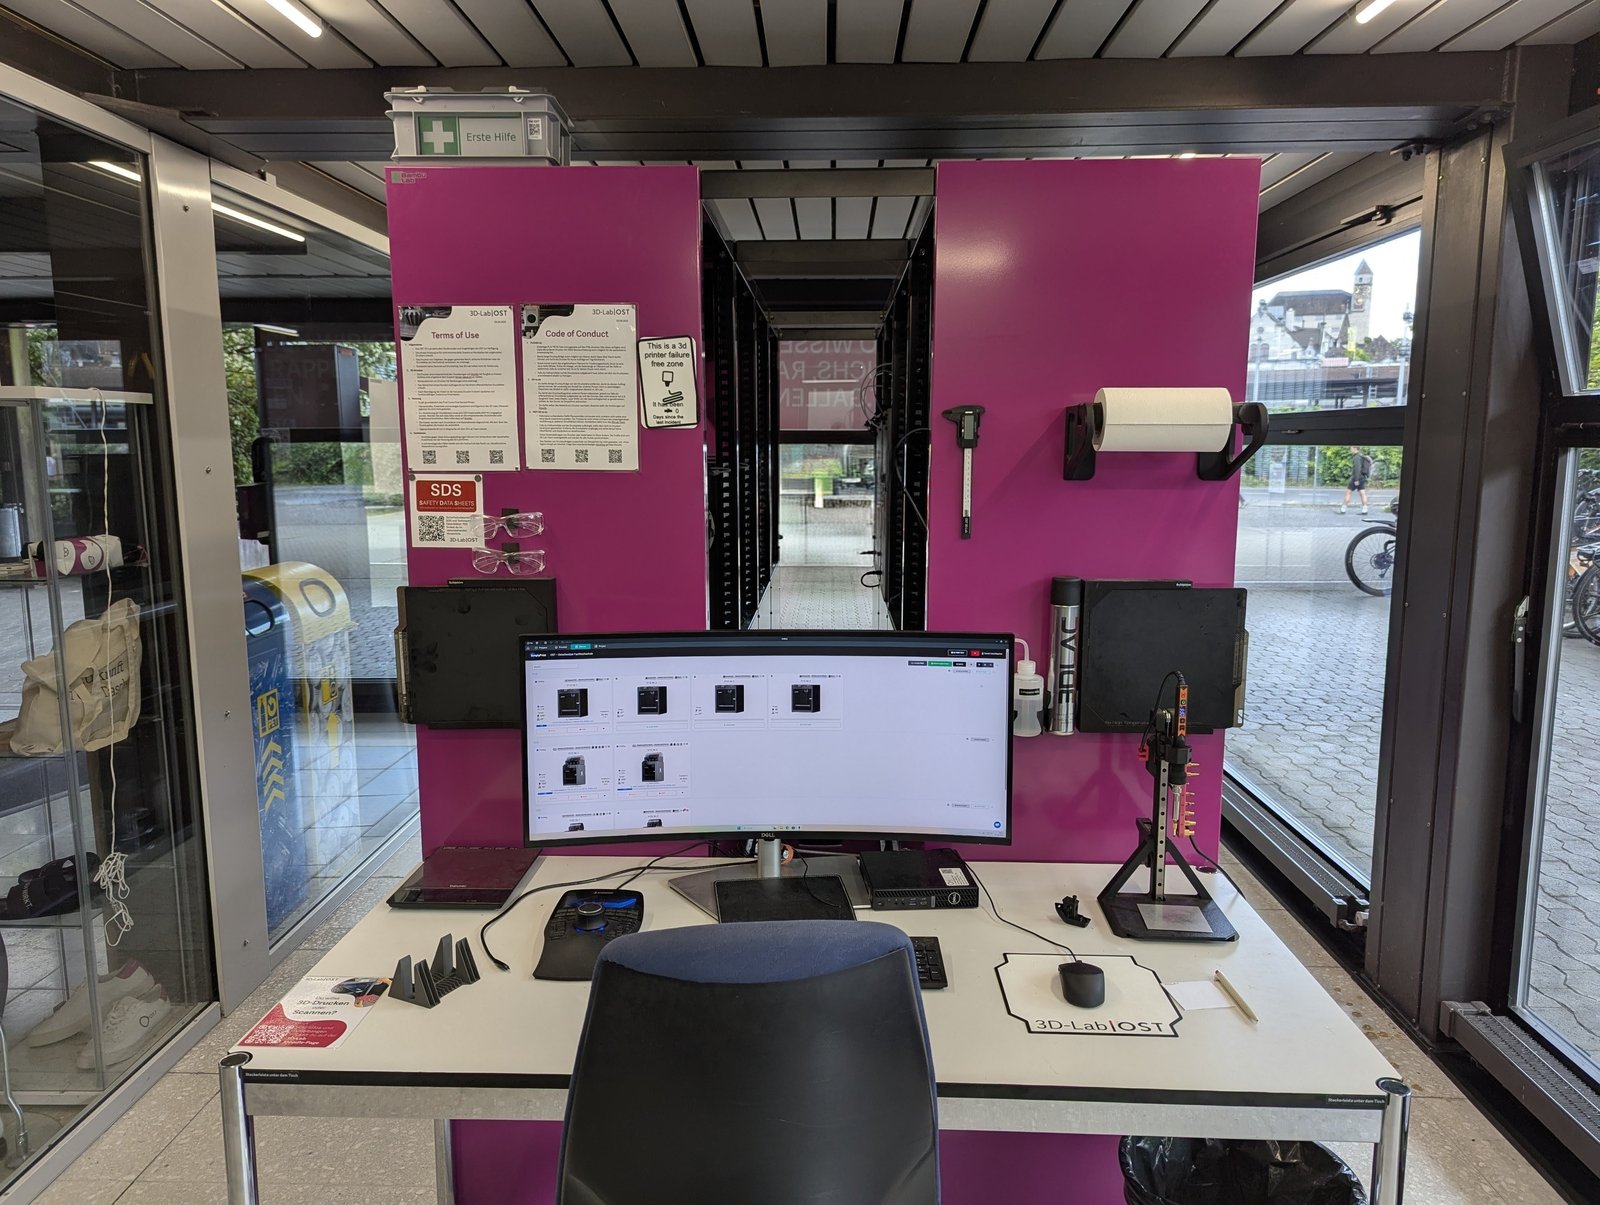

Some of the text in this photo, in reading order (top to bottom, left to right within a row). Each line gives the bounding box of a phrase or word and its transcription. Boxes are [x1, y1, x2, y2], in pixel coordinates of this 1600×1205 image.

[466, 132, 517, 142] Erste Hilfe
[431, 331, 480, 340] Terms of Use
[545, 329, 609, 338] Code of Conduct
[644, 350, 690, 359] printer failure
[430, 483, 462, 497] SDS
